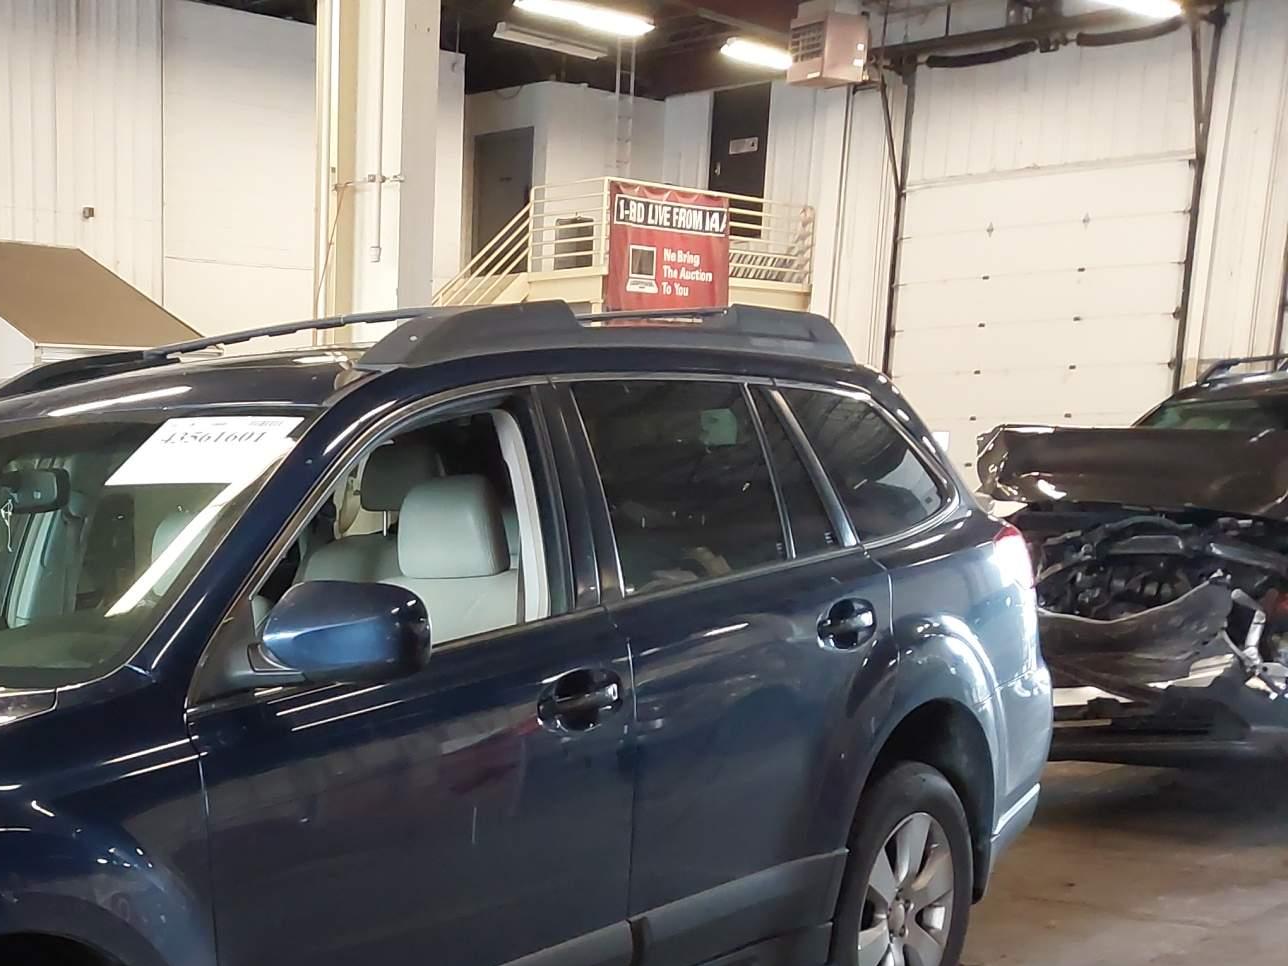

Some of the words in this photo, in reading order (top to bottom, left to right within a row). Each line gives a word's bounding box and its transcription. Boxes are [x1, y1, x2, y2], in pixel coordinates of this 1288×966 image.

[647, 203, 672, 227] LIVE
[672, 207, 703, 230] FROM
[677, 249, 701, 267] Bring
[662, 264, 678, 279] The
[679, 266, 713, 282] Auction
[661, 281, 672, 295] To
[673, 282, 689, 297] You
